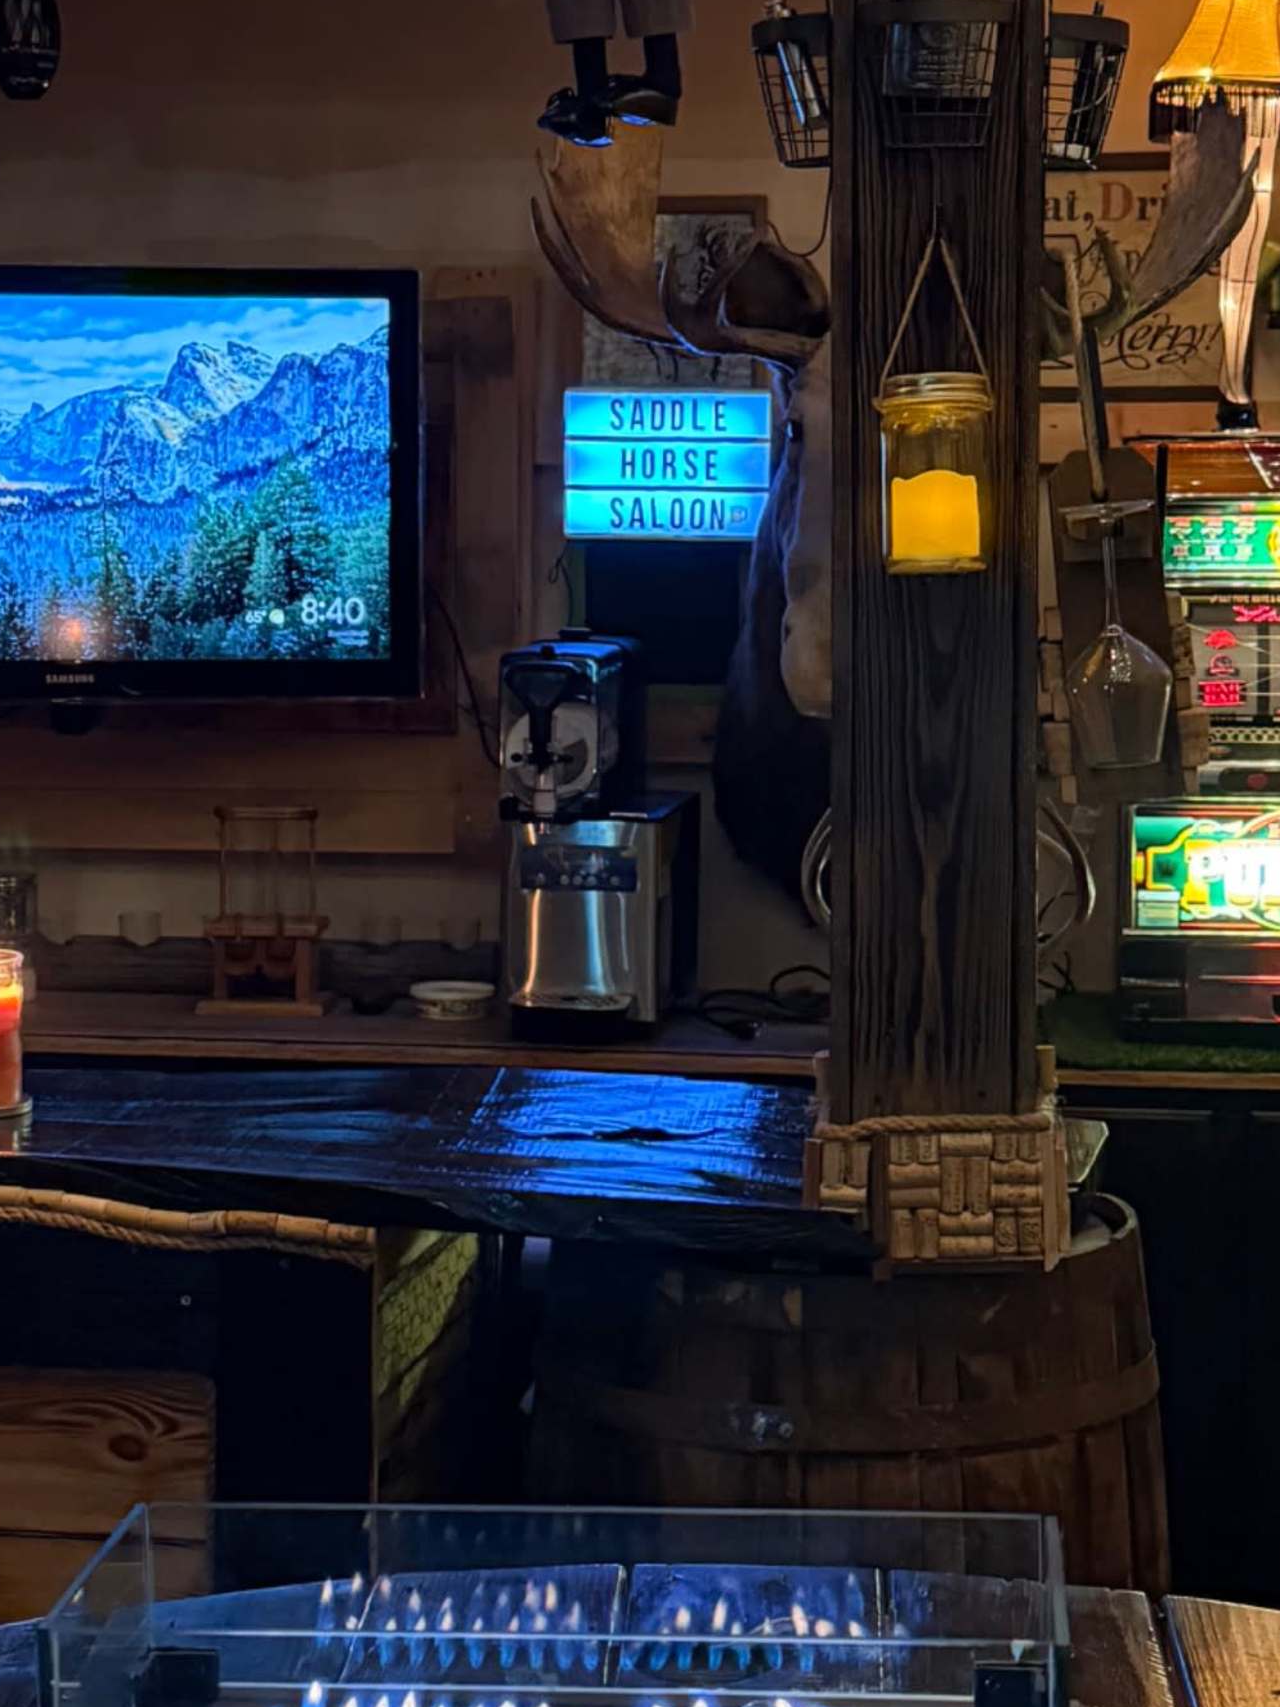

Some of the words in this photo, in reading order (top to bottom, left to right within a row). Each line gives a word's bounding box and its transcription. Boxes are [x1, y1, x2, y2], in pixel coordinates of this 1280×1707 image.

[1043, 190, 1095, 231] at,
[609, 397, 728, 433] SADDLE
[620, 448, 719, 482] HORSE
[609, 496, 726, 531] SALOON
[300, 595, 366, 625] 8:40
